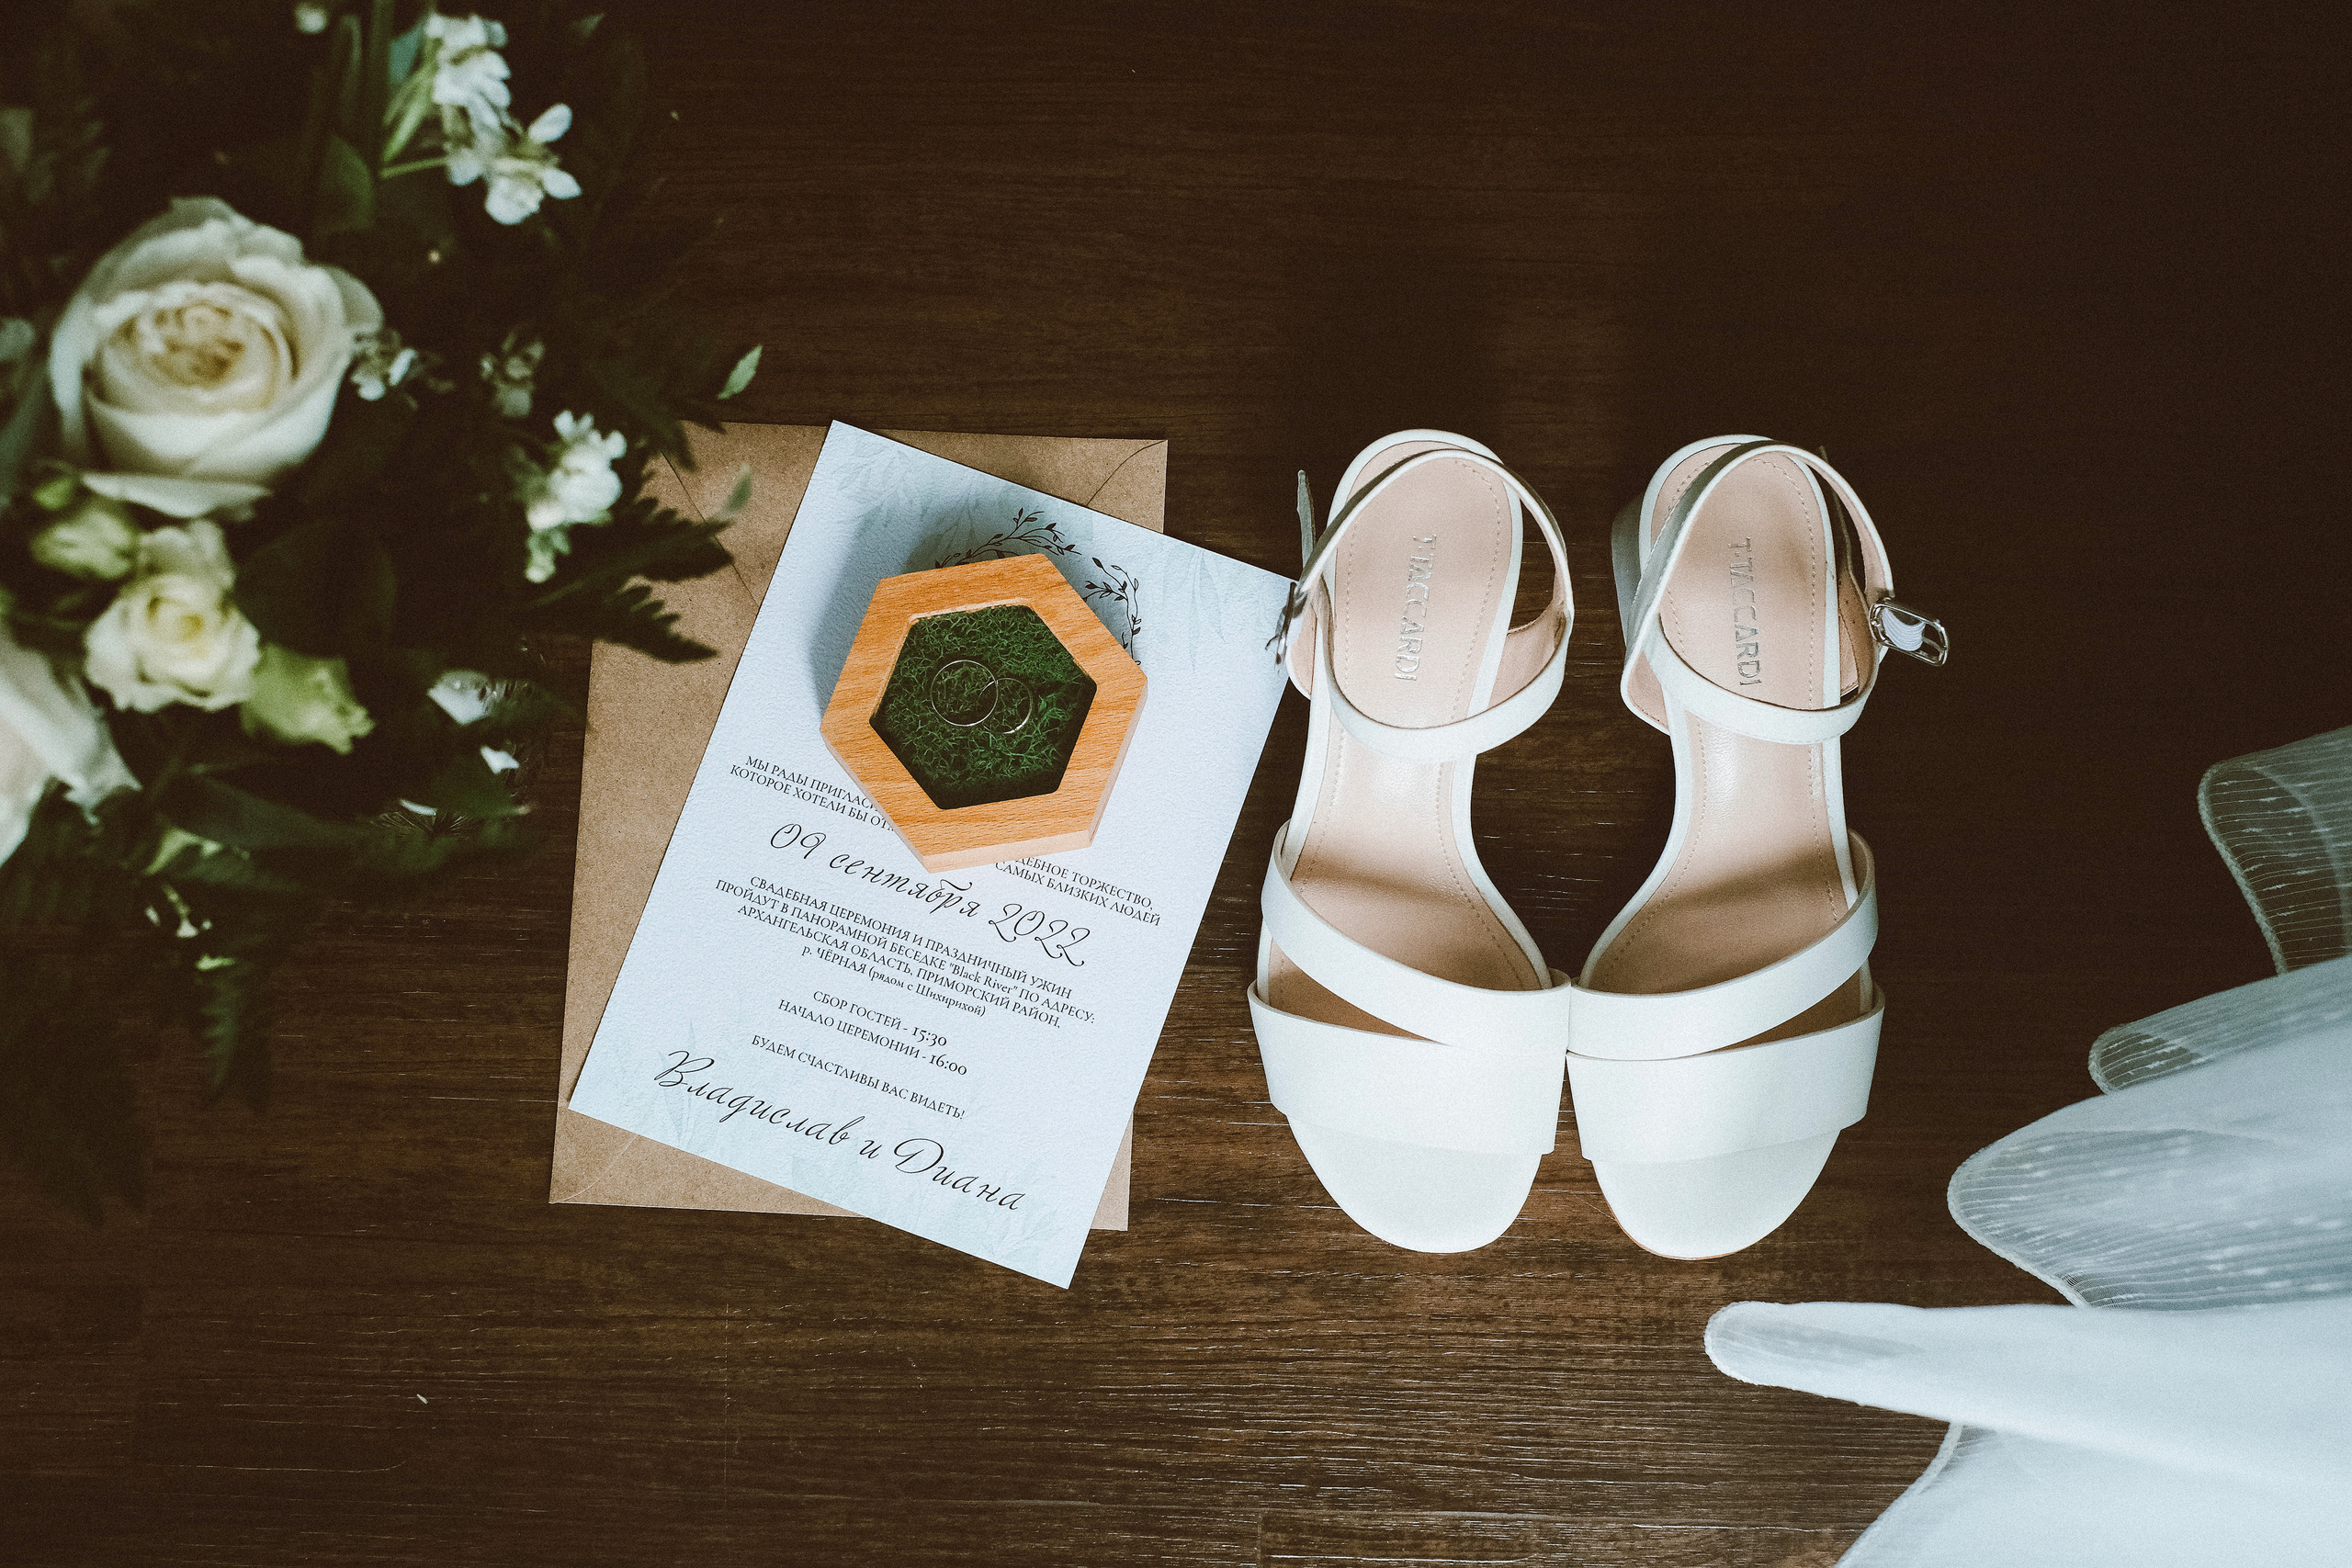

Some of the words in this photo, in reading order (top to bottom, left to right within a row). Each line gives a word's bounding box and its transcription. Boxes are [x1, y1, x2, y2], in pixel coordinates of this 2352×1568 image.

[729, 763, 792, 795] КОТОРОЕ
[791, 785, 847, 815] ХОТЕЛИ
[846, 806, 869, 823] БЫ
[994, 861, 1046, 886] САМЫХ
[1045, 876, 1110, 908] БЛИЗКИХ
[1108, 900, 1161, 927] ЛЮДЕЙ
[744, 754, 770, 773] МЫ
[769, 763, 809, 787] РАДЫ
[808, 777, 878, 812] ПРИГЛАС
[1070, 870, 1153, 911] ТОРЖЕСТВО,
[769, 822, 827, 860] 09
[828, 852, 981, 918] сентября
[987, 902, 1091, 967] 2022
[714, 878, 780, 910] ПРОЙДУТ
[778, 901, 789, 914] В
[789, 905, 888, 950] ПАНОРАМНОЙ
[888, 941, 947, 971] БЕСЕДКЕ
[948, 961, 982, 984] "Black
[981, 974, 1019, 995] River"
[1017, 987, 1040, 1003] ПО
[1039, 997, 1095, 1024] АДРЕСУ:
[736, 904, 850, 952] АРХАНГЕЛЬСКАЯ
[914, 966, 1011, 1010] ПРИМОРСКИЙ
[749, 875, 829, 912] СВАДЕБНАЯ
[828, 902, 911, 942] ЦЕРЕМОНИЯ
[910, 932, 923, 947] И
[923, 937, 1028, 984] ПРАЗДНИЧНЫЙ
[1028, 975, 1073, 999] УЖИН
[800, 944, 812, 957] р.
[816, 946, 867, 975] ЧЁРНАЯ
[867, 964, 905, 988] (рядом
[906, 982, 914, 991] с
[750, 1033, 797, 1059] БУДЕМ
[797, 1051, 880, 1090] СЧАСТЛИВЫ
[879, 1080, 910, 1100] ВАС
[908, 1090, 966, 1120] ВИДЕТЬ!
[776, 998, 835, 1028] НАЧАЛО
[835, 1019, 921, 1059] ЦЕРЕМОНИИ
[927, 1053, 967, 1076] 16:00
[812, 989, 848, 1010] СБОР
[847, 1001, 901, 1031] ГОСТЕЙ
[910, 1025, 947, 1047] 15:30
[652, 1049, 865, 1145] Владислав
[857, 1138, 883, 1159] и
[892, 1136, 1026, 1211] Диана
